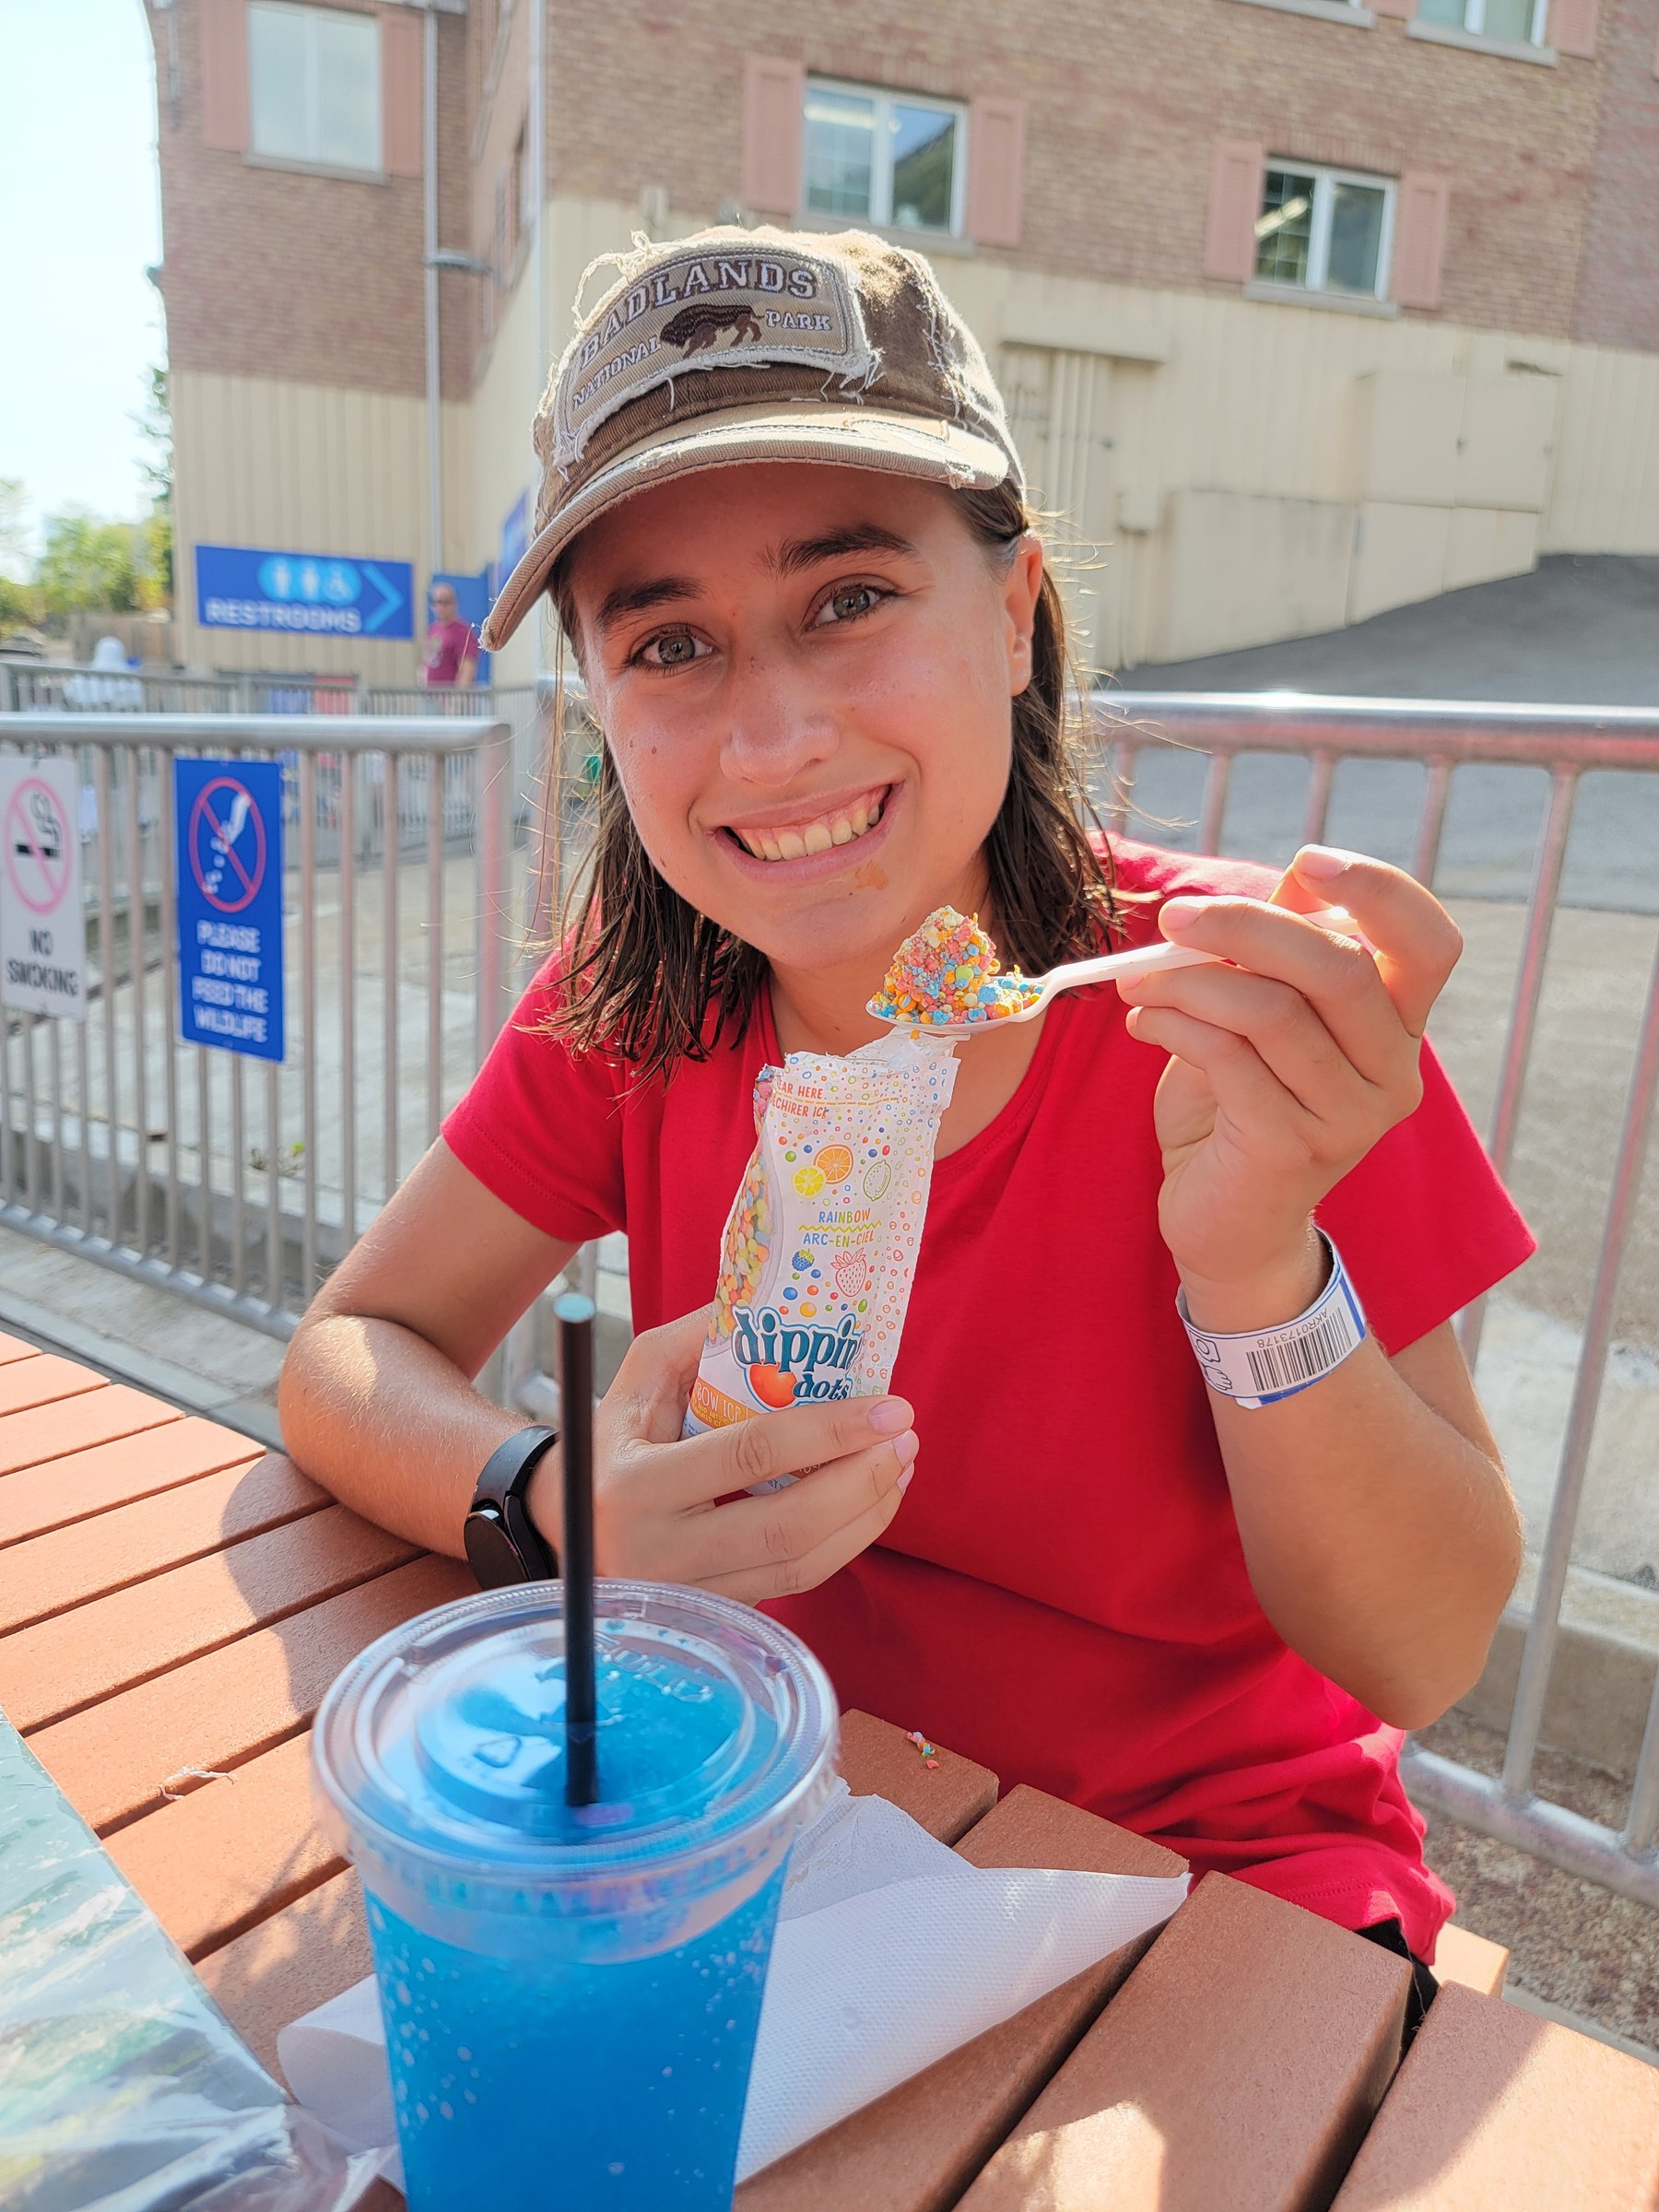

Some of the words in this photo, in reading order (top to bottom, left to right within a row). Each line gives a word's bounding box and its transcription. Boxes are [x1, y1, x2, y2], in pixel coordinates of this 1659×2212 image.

[581, 260, 817, 368] BADLANDS
[572, 335, 662, 408] NATIONAL
[765, 309, 833, 332] PARK
[205, 597, 362, 633] RESTROOMS
[29, 928, 53, 956] NO
[196, 919, 261, 953] PLEASE
[6, 958, 78, 996] SMOKING
[200, 948, 226, 977] DO
[226, 953, 262, 982] NOT
[192, 975, 235, 1006] FEED
[234, 982, 269, 1014] THE
[193, 1004, 268, 1043] WILDLIFE
[818, 1207, 871, 1224] RAINBOW
[803, 1230, 874, 1248] ARC-EN-CIEL
[1256, 1307, 1328, 1349] AKR0173178
[793, 1373, 850, 1400] dots
